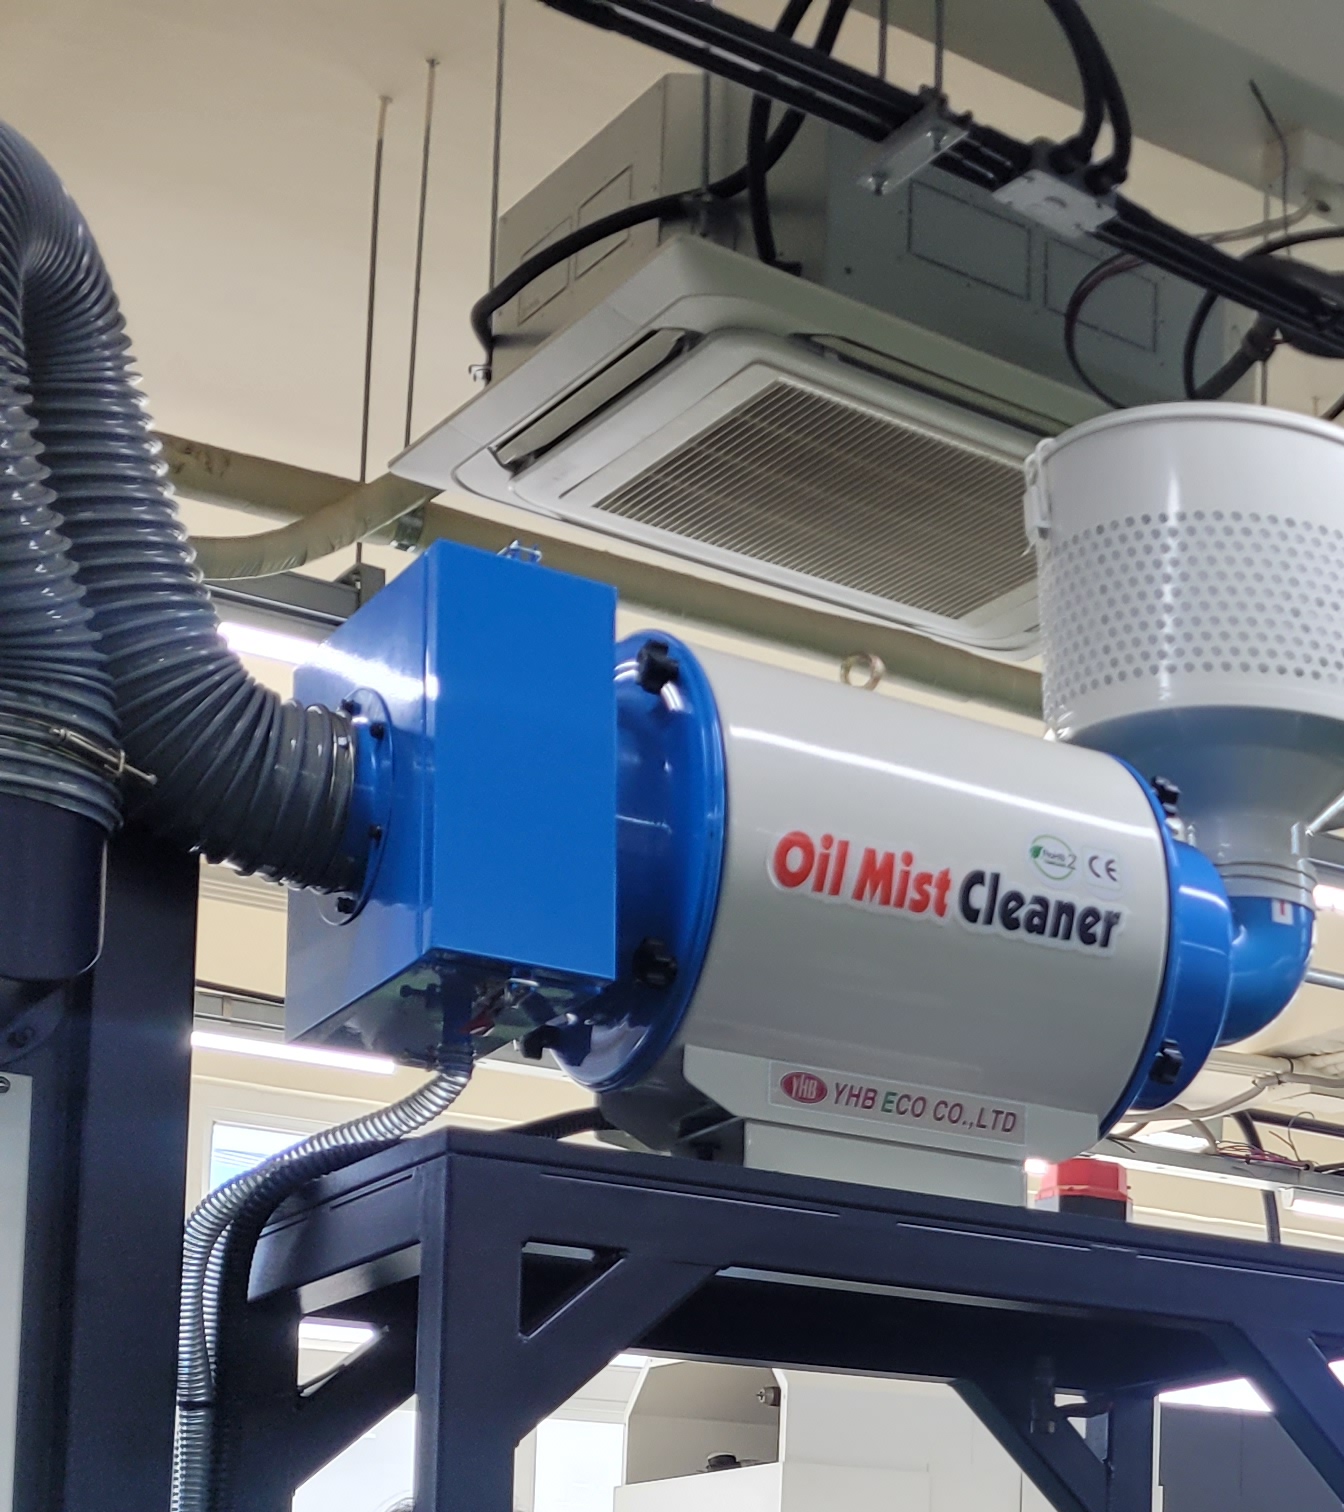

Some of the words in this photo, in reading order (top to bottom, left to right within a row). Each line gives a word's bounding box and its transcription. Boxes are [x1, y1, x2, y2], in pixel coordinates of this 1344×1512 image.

[773, 831, 850, 896] Oil
[852, 848, 951, 918] Mist
[959, 870, 1121, 948] Cleaner
[792, 1075, 818, 1099] YHB
[834, 1083, 878, 1110] YHB
[881, 1091, 927, 1118] ECO
[933, 1100, 1018, 1133] CO.,LTD
